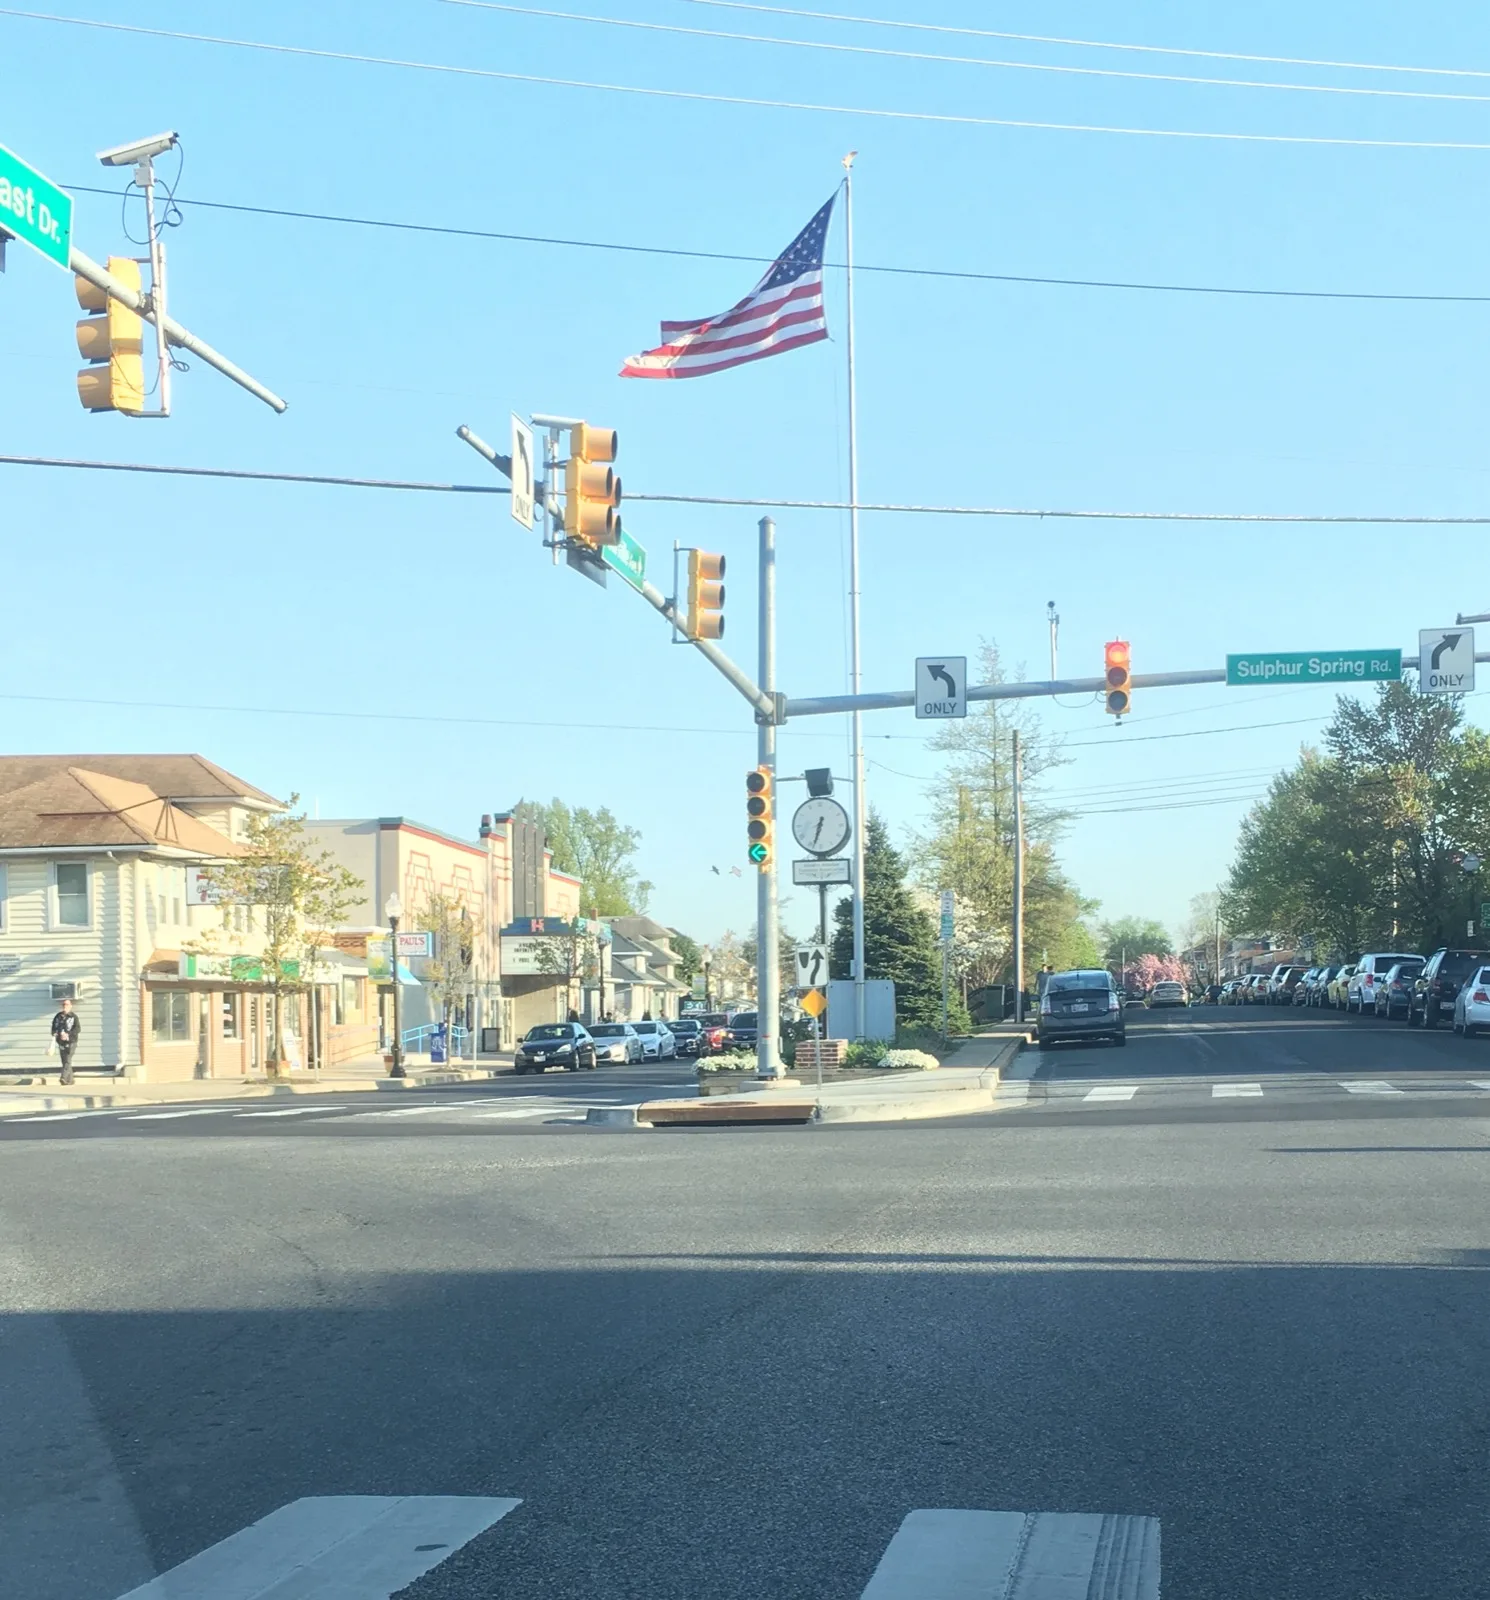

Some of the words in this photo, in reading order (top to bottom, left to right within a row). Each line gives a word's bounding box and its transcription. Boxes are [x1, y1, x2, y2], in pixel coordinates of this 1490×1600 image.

[38, 202, 61, 245] Dr.
[1237, 659, 1303, 680] Sulphur
[1308, 657, 1365, 677] Spring
[1370, 659, 1392, 673] Rd.
[1429, 674, 1464, 688] ONLY
[924, 702, 957, 715] ONLY
